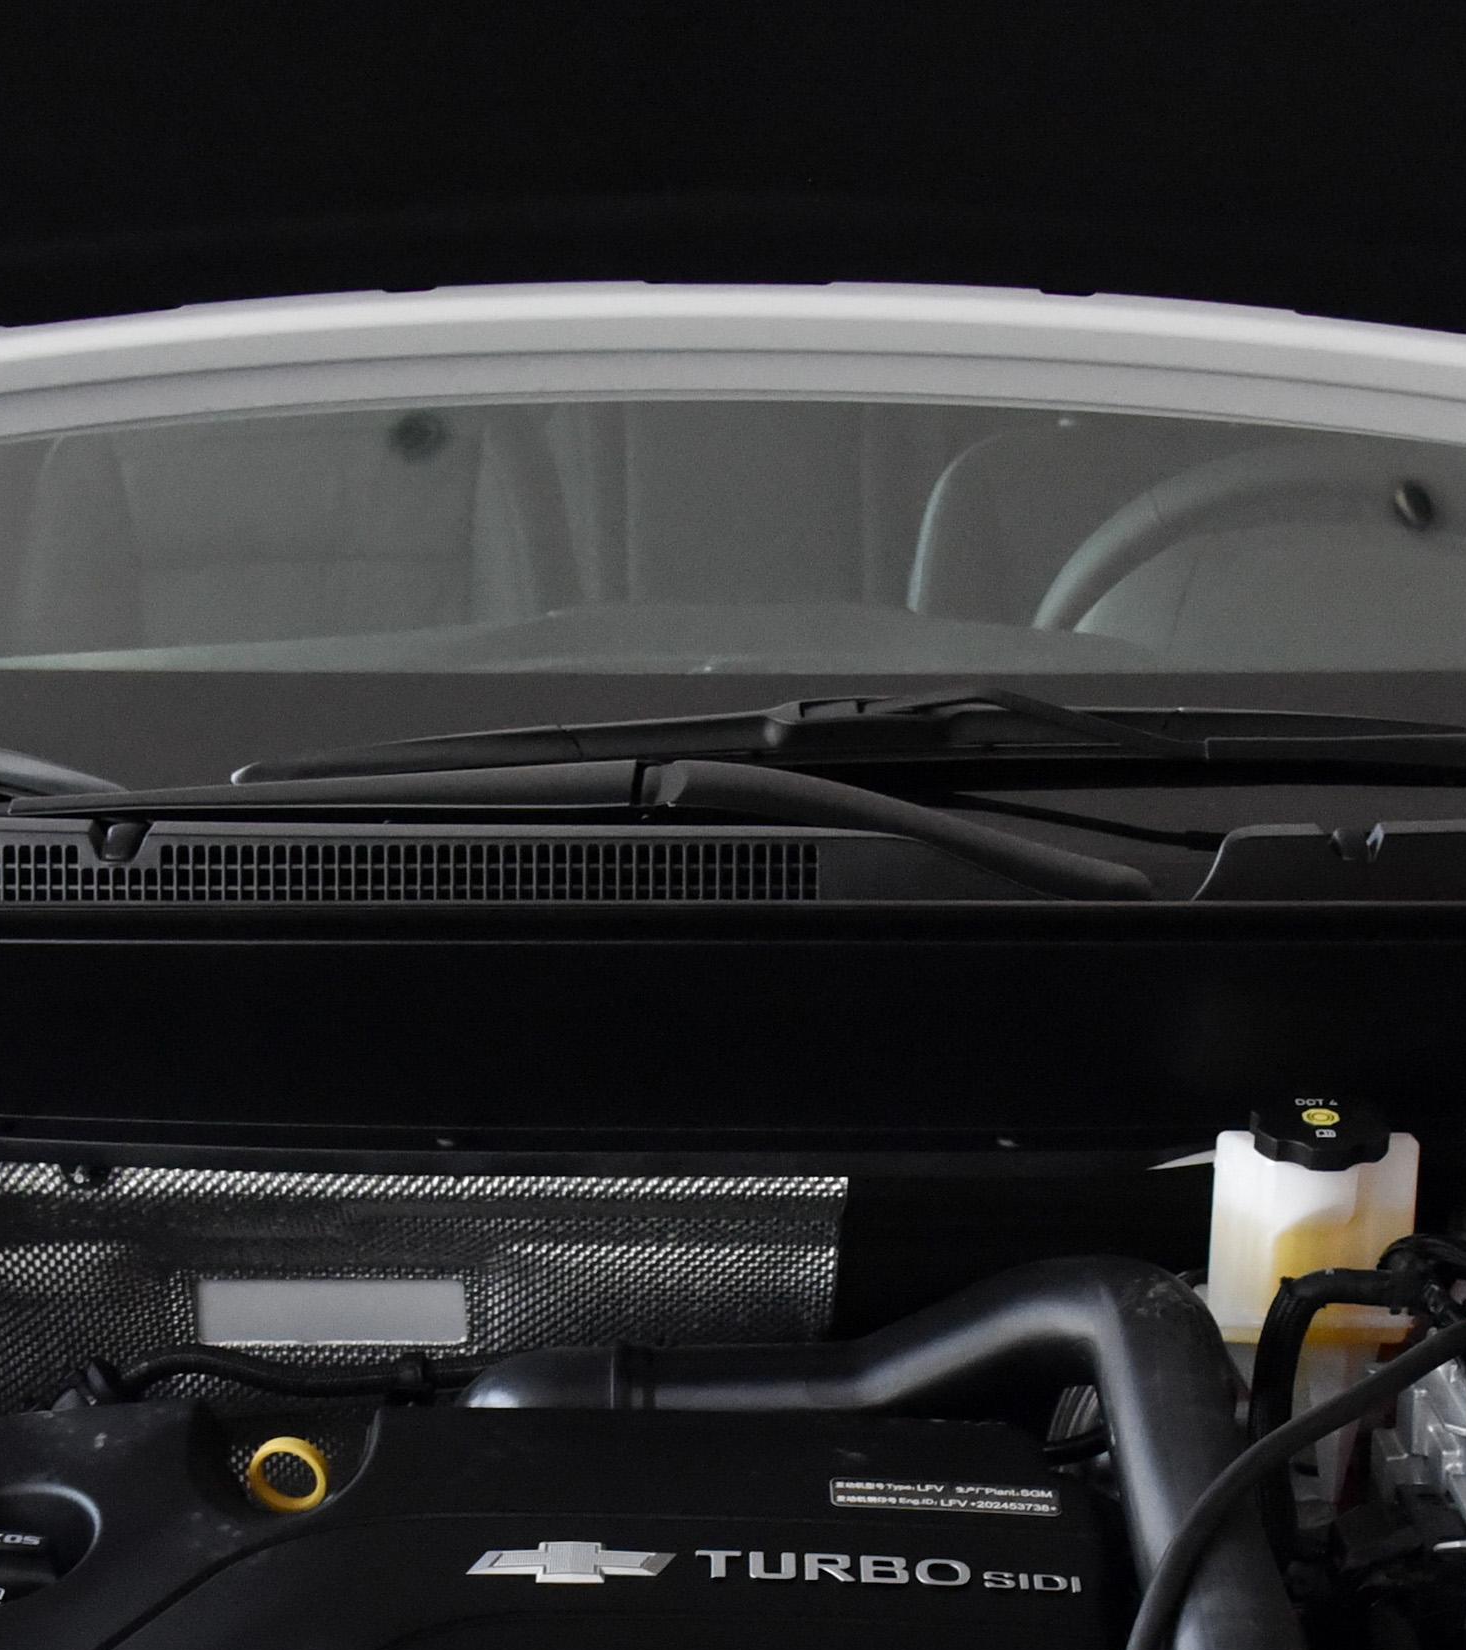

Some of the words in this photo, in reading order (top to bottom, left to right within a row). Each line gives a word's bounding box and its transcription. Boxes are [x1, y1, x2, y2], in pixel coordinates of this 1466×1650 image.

[1294, 1098, 1324, 1106] DOT
[917, 1484, 945, 1492] LFV
[940, 1499, 968, 1507] LFV
[694, 1548, 972, 1588] TURBO
[982, 1570, 1082, 1595] SIDI
